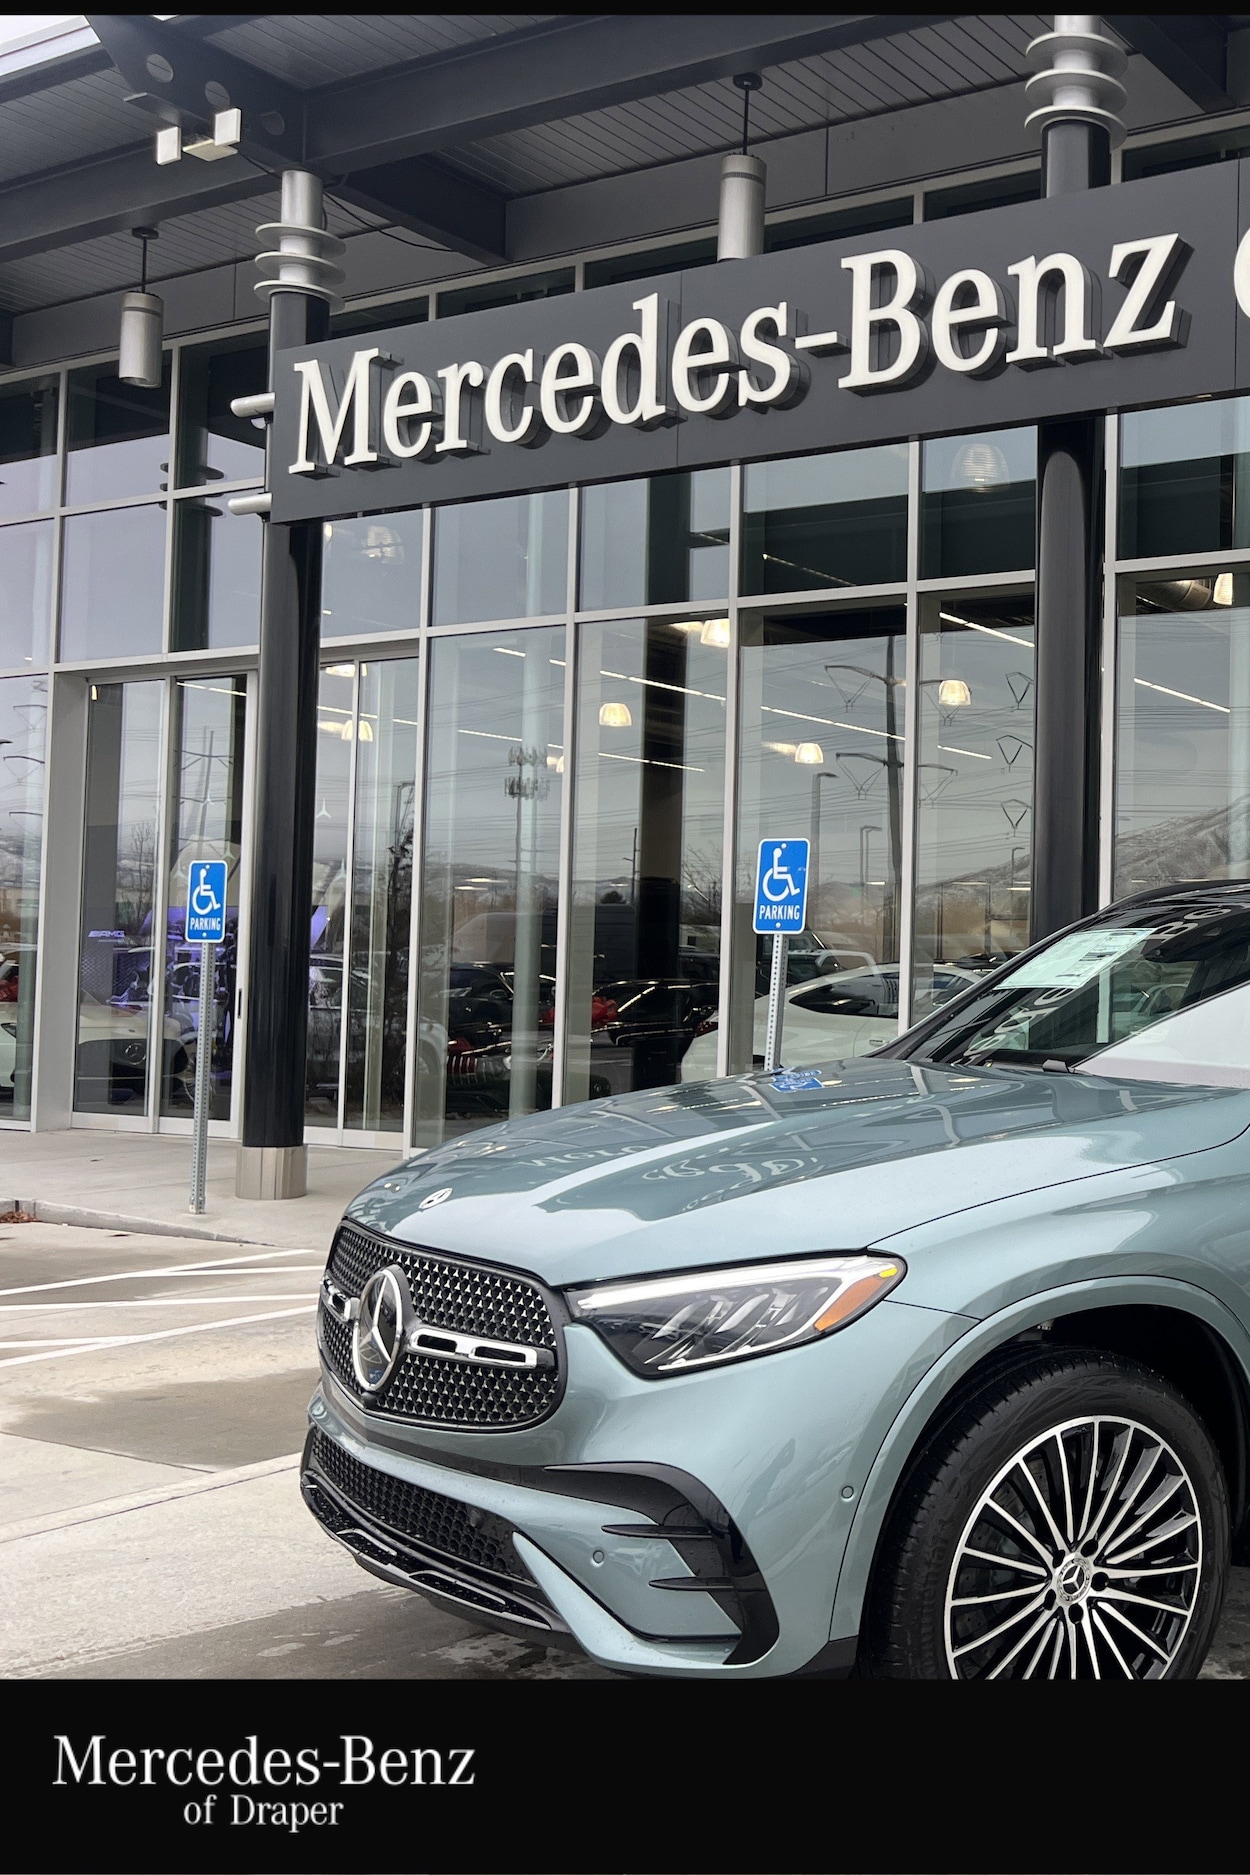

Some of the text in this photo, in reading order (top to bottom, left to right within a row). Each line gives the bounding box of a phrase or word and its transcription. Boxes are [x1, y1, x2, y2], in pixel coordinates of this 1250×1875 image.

[289, 234, 1184, 474] Mercedes-Benz
[759, 904, 800, 920] PARKING
[190, 917, 220, 930] PARKING
